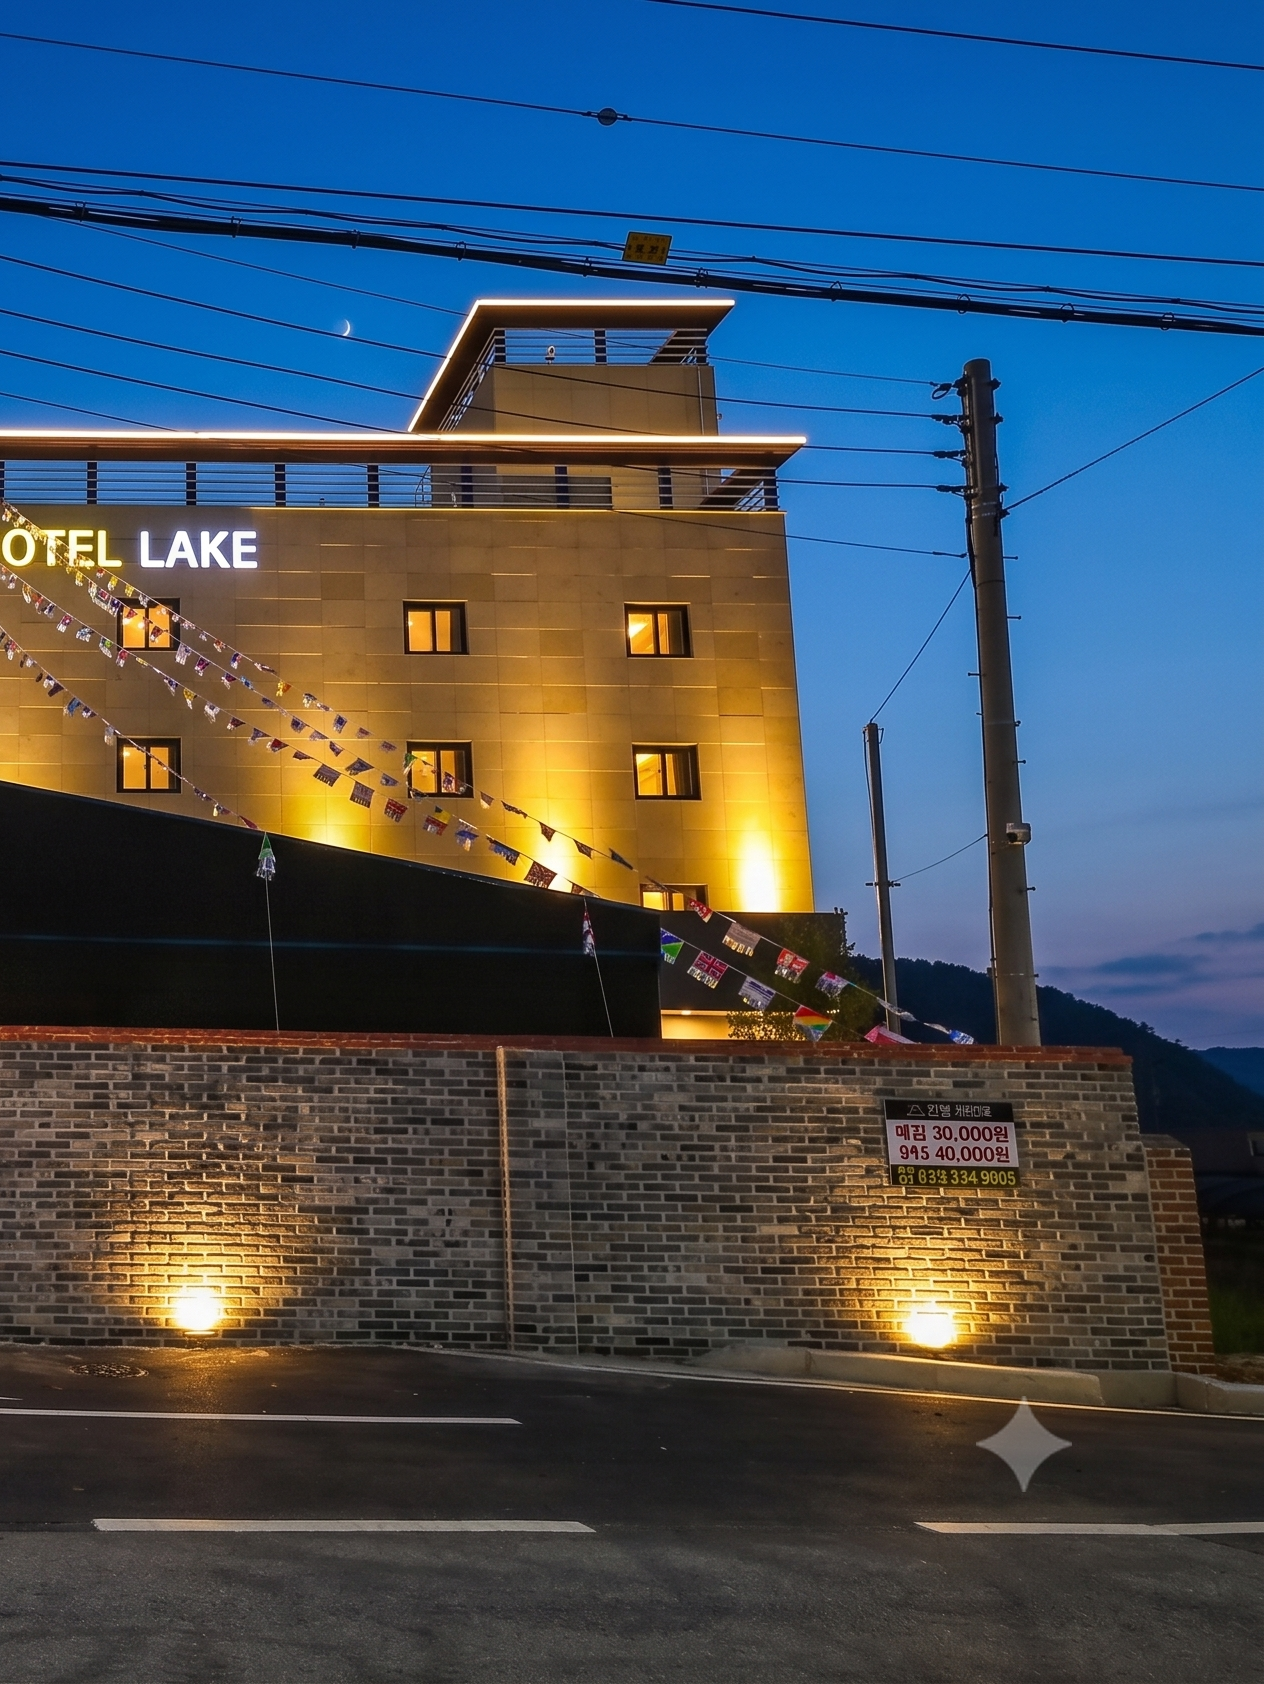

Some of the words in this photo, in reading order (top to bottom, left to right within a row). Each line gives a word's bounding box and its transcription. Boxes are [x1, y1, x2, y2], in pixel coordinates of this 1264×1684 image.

[140, 530, 258, 568] LAKE
[932, 1125, 1009, 1143] 30,000원
[935, 1145, 1010, 1163] 40,000원
